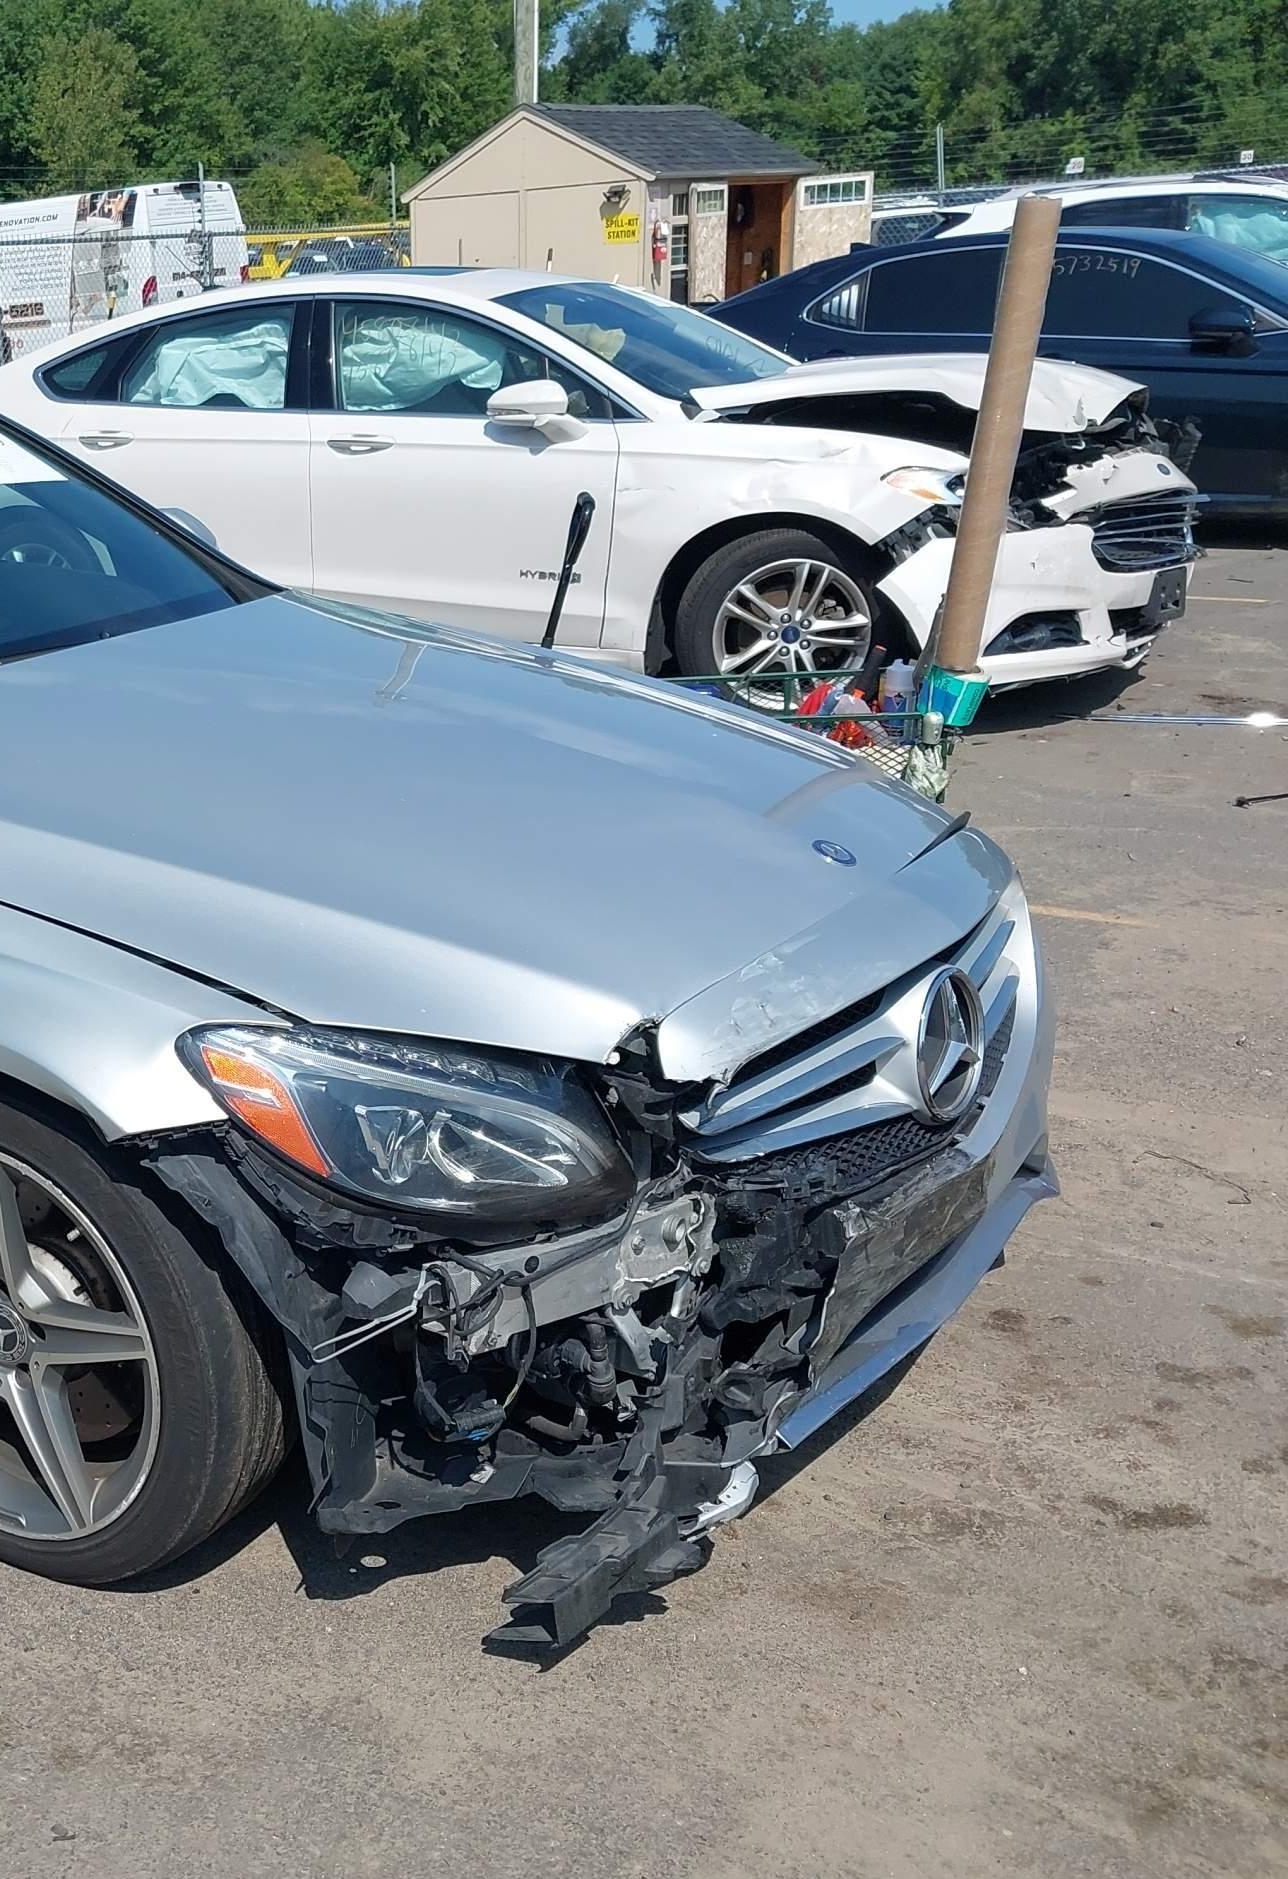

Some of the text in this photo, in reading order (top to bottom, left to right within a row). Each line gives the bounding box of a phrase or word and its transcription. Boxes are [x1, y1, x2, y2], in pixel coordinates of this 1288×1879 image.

[605, 217, 639, 228] SPILL-KIT
[607, 230, 636, 240] STATION
[519, 569, 570, 582] HYBRI
